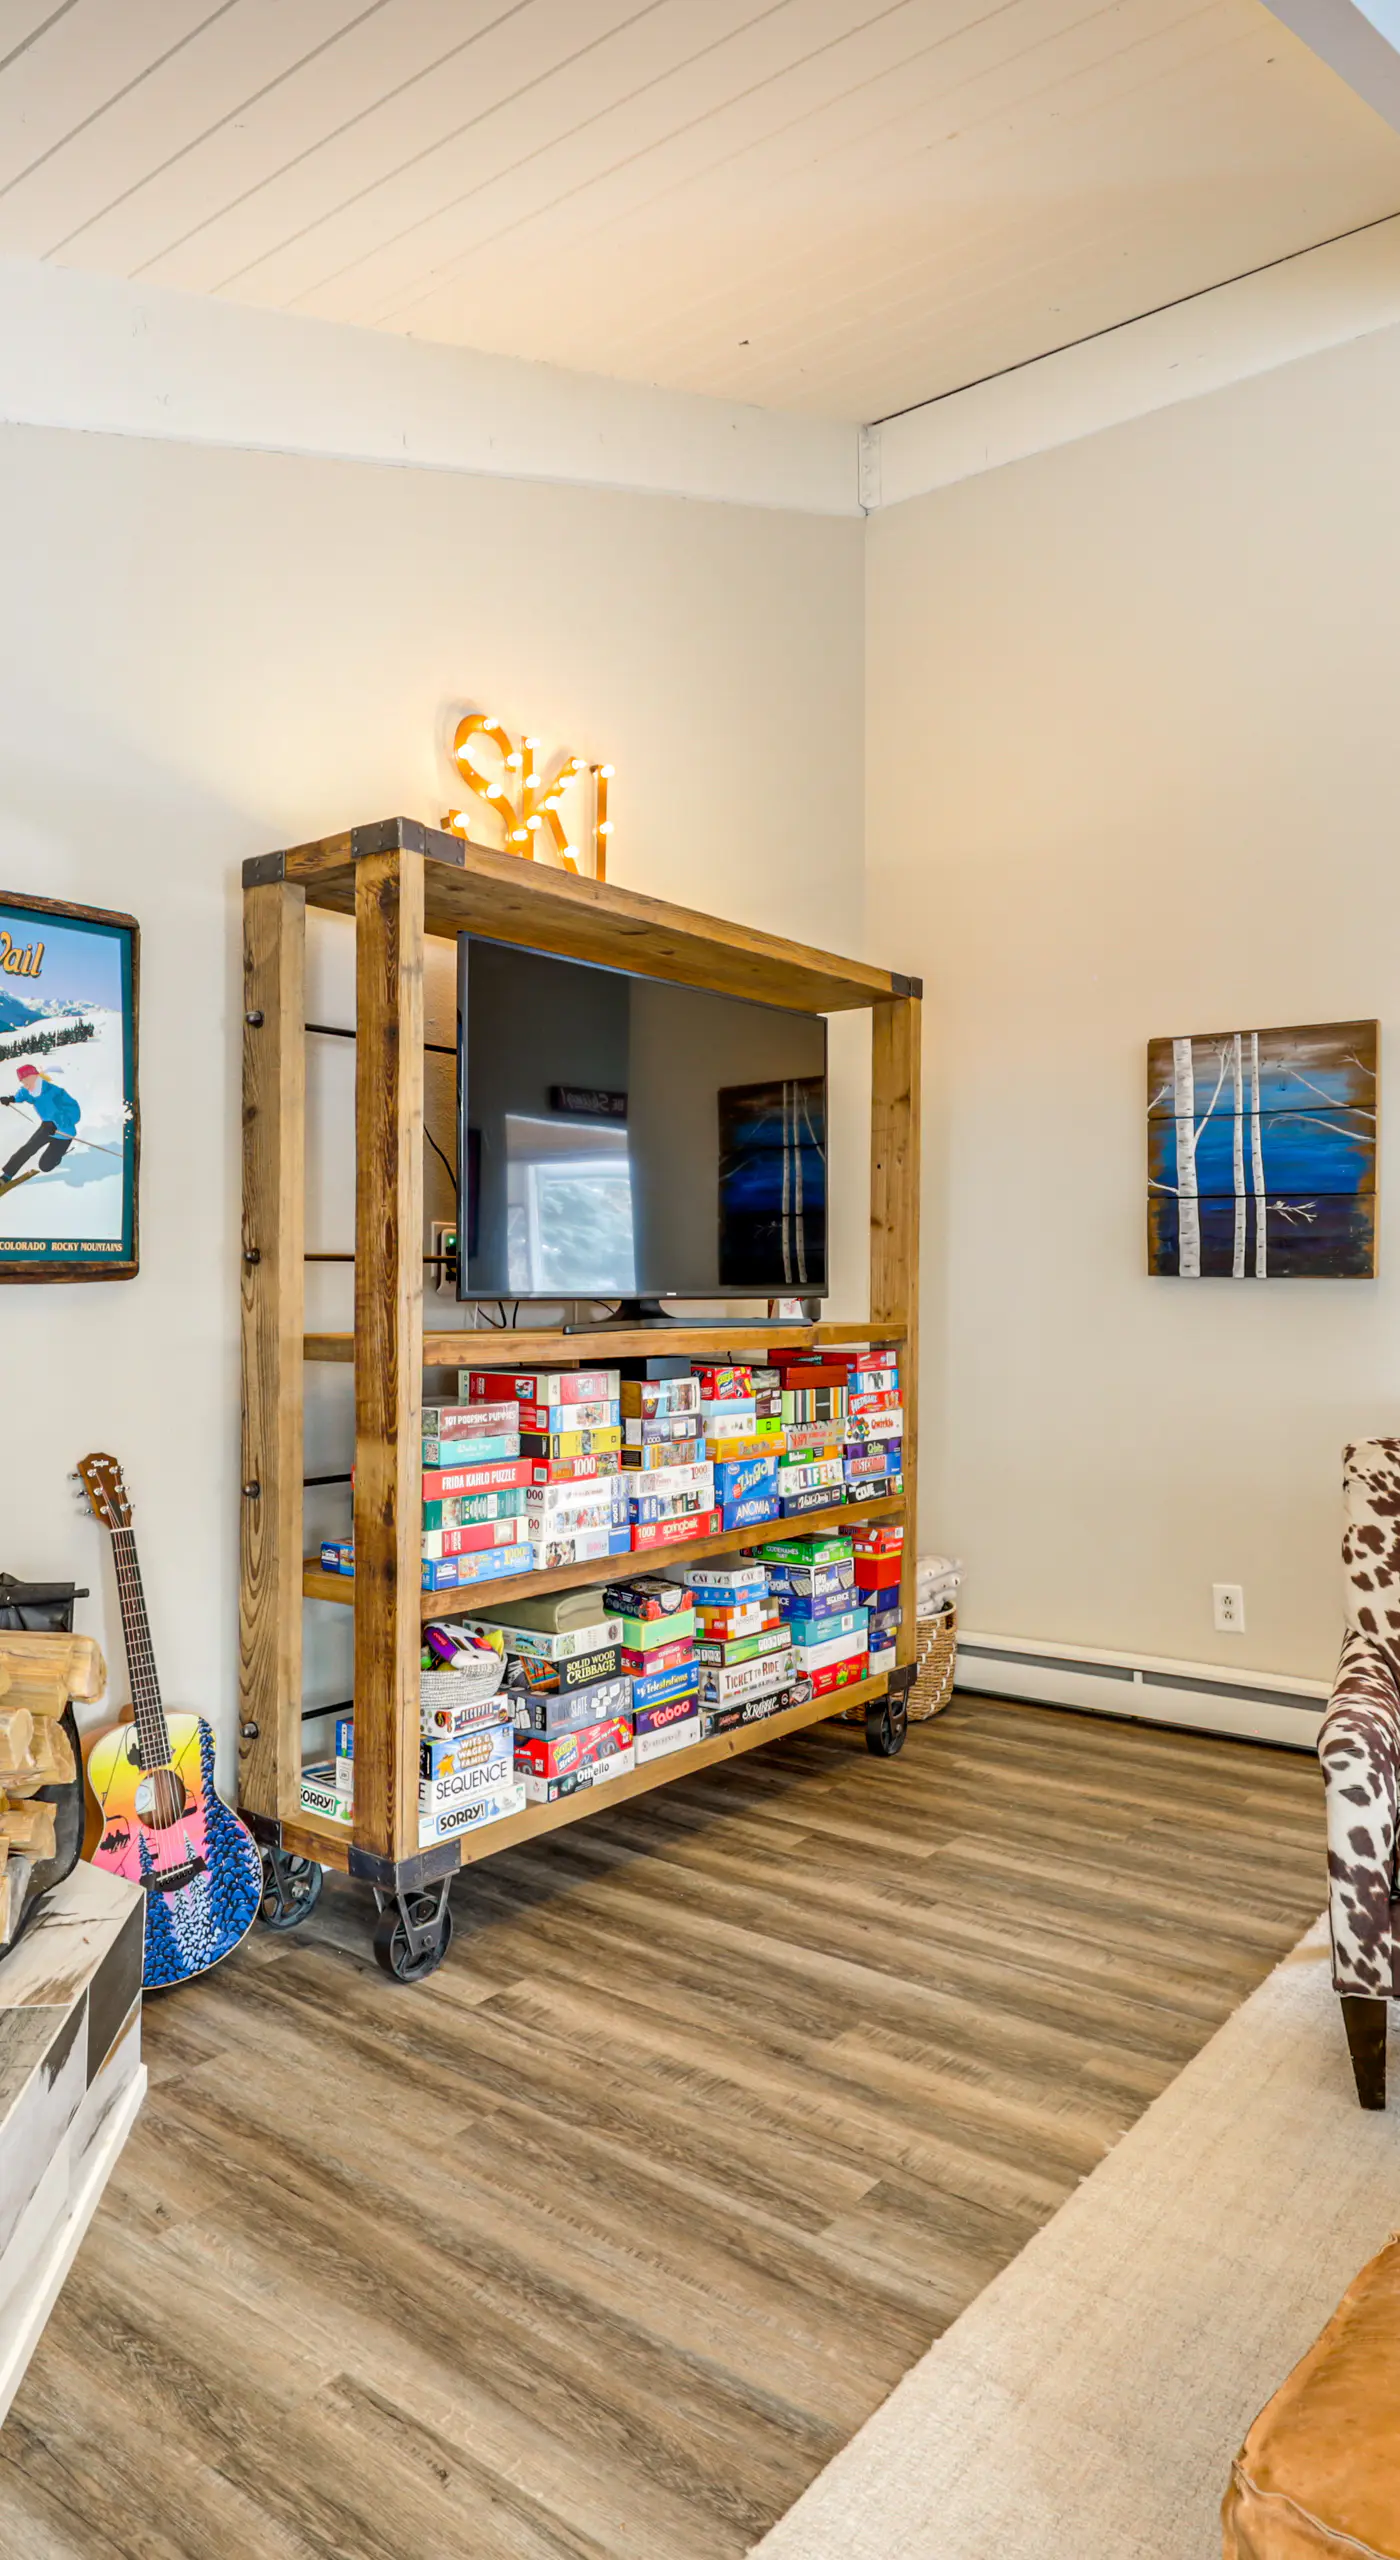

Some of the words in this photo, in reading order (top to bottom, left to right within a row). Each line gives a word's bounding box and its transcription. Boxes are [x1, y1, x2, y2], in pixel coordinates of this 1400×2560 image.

[450, 714, 615, 884] SKI
[0, 1242, 46, 1251] COLORADO
[51, 1242, 79, 1251] ROCKY
[80, 1242, 123, 1252] MOUNTAINS
[574, 1457, 596, 1476] 1000
[690, 1465, 707, 1480] 1000
[799, 1465, 829, 1489] LIFE
[442, 1476, 465, 1490] FRIDA
[466, 1472, 490, 1487] KAHLO
[491, 1468, 517, 1484] PUZZLE
[736, 1499, 770, 1520] ANOMIA
[637, 1525, 656, 1538] 1000
[567, 1657, 590, 1673] SOLID
[592, 1650, 615, 1664] WOOD
[567, 1659, 616, 1684] CRIBBAGE
[725, 1670, 753, 1690] TICKET
[762, 1660, 779, 1676] RIDE
[571, 1695, 588, 1718] SLATE
[650, 1700, 690, 1727] Taboo
[458, 1741, 493, 1759] WAGERS
[461, 1737, 482, 1749] WITS
[559, 1750, 577, 1770] Street
[436, 1761, 507, 1800] SEQUENCE
[577, 1763, 610, 1783] Othello
[440, 1803, 485, 1831] SORRY!
